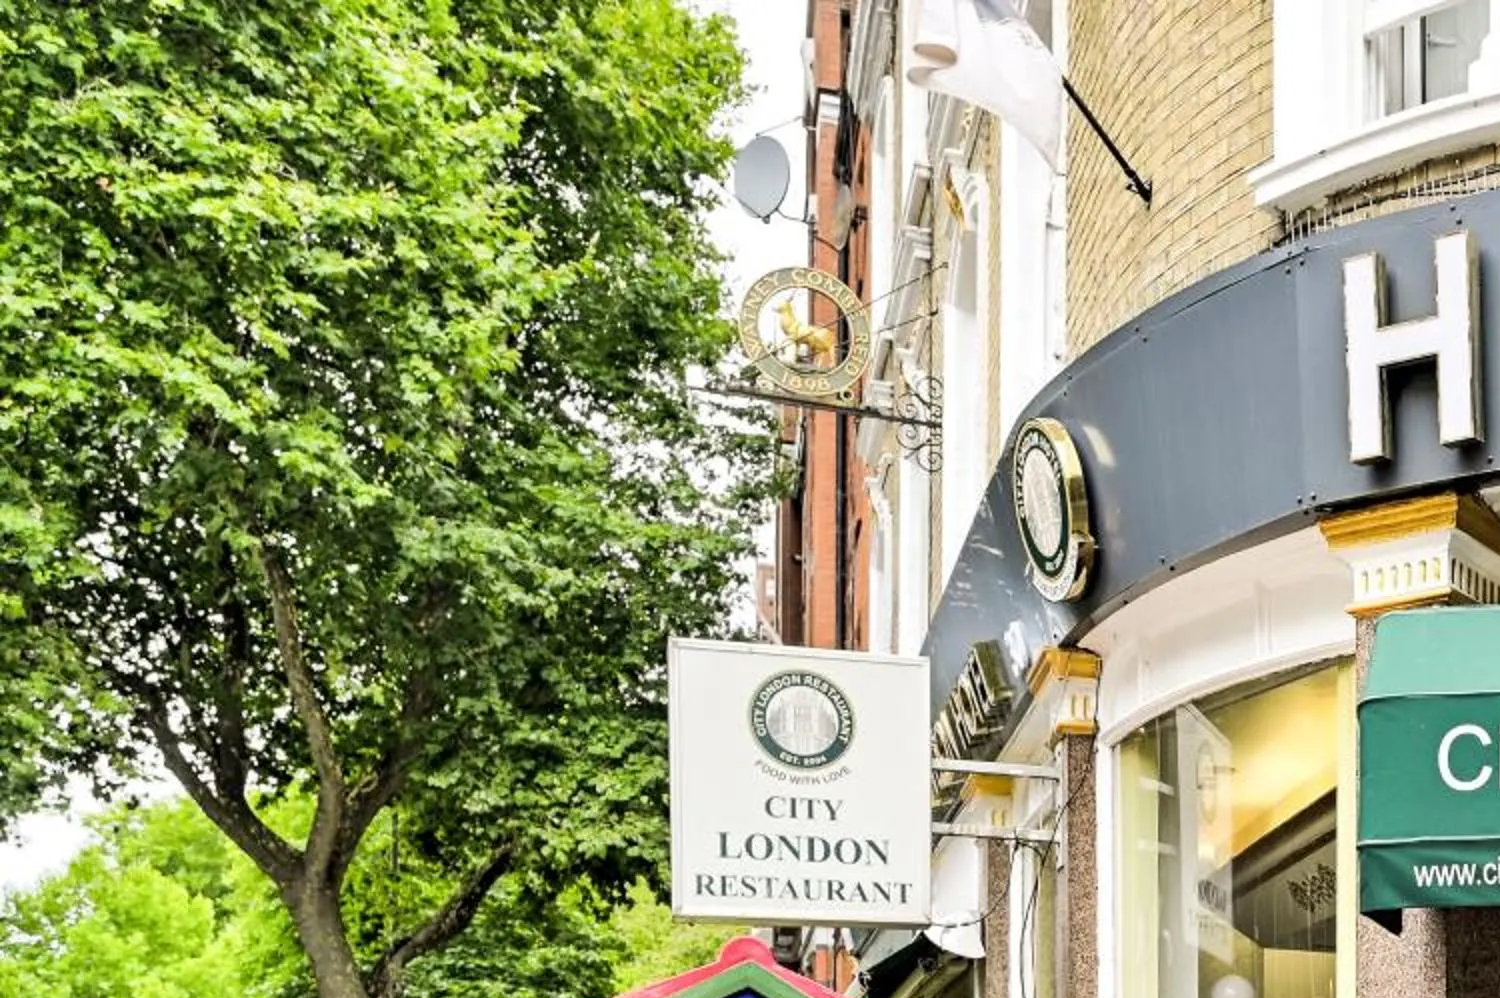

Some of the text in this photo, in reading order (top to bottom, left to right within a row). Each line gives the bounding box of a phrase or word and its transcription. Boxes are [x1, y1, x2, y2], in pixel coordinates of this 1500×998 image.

[753, 674, 852, 744] CITY LONDON RESTAURANT
[754, 760, 787, 782] FOOD
[763, 795, 844, 822] CITY
[718, 831, 890, 866] LONDON
[694, 873, 913, 905] RESTAURANT
